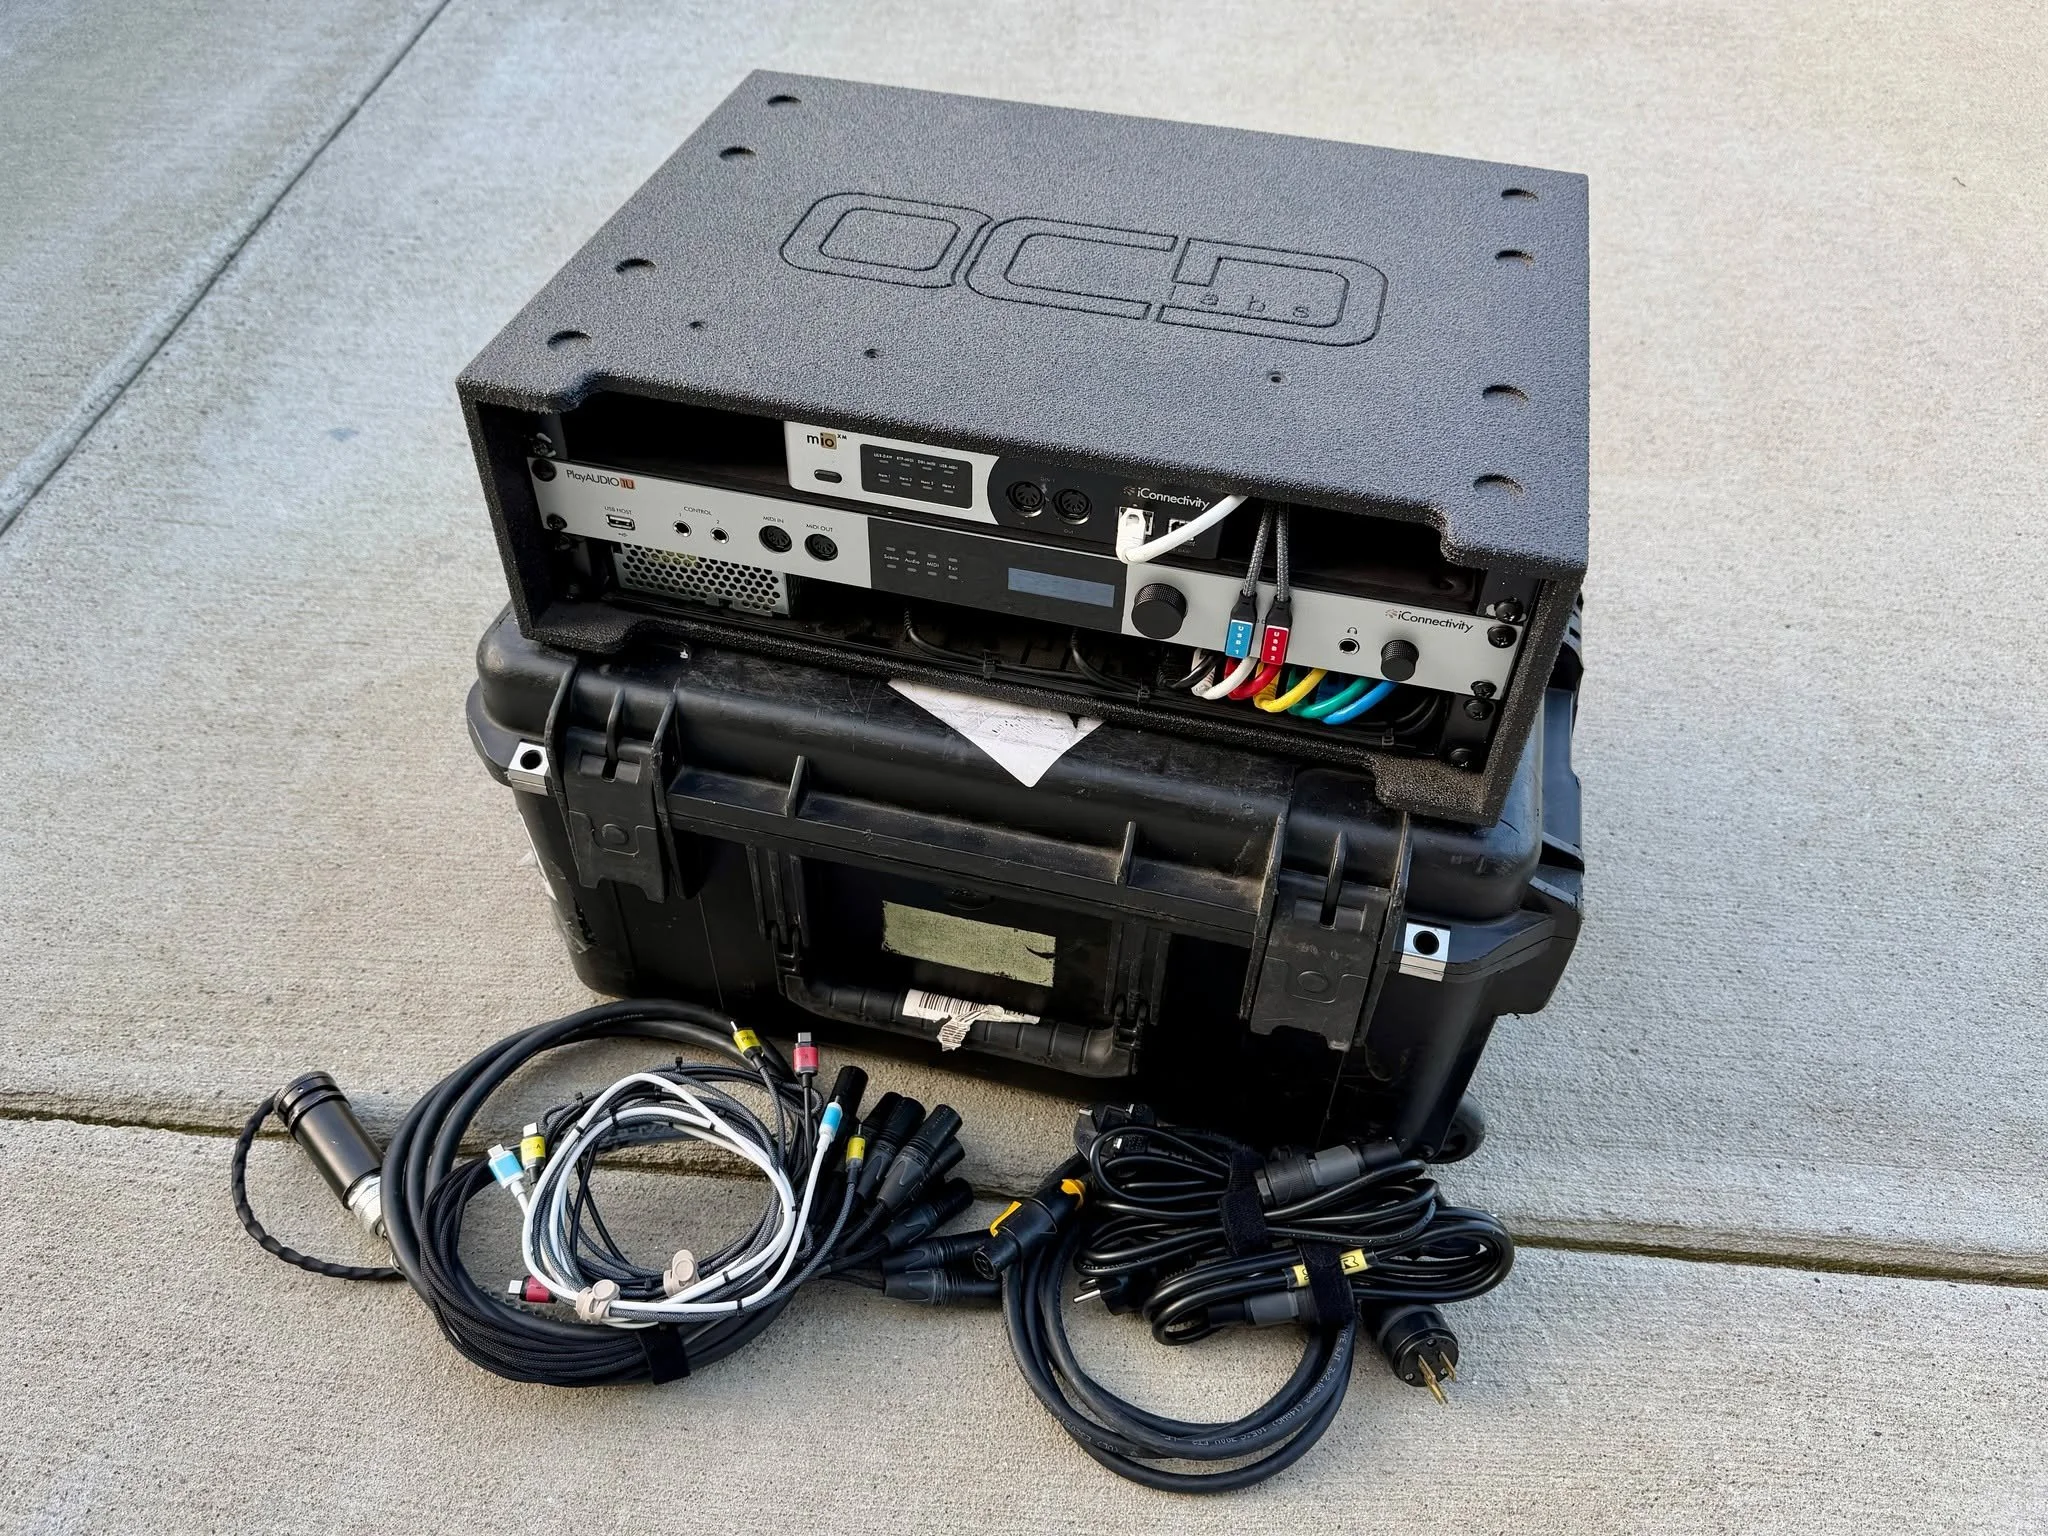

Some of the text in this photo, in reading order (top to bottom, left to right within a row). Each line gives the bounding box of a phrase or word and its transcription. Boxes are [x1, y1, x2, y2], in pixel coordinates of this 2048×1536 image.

[1137, 487, 1210, 511] iConnectivity
[616, 507, 632, 515] HOST
[683, 505, 713, 516] CONTROL
[762, 515, 777, 523] MIDI
[805, 523, 833, 533] MIDI OUT
[904, 557, 921, 565] Audio
[926, 561, 940, 569] MIDI
[1398, 610, 1474, 634] iConnectivity
